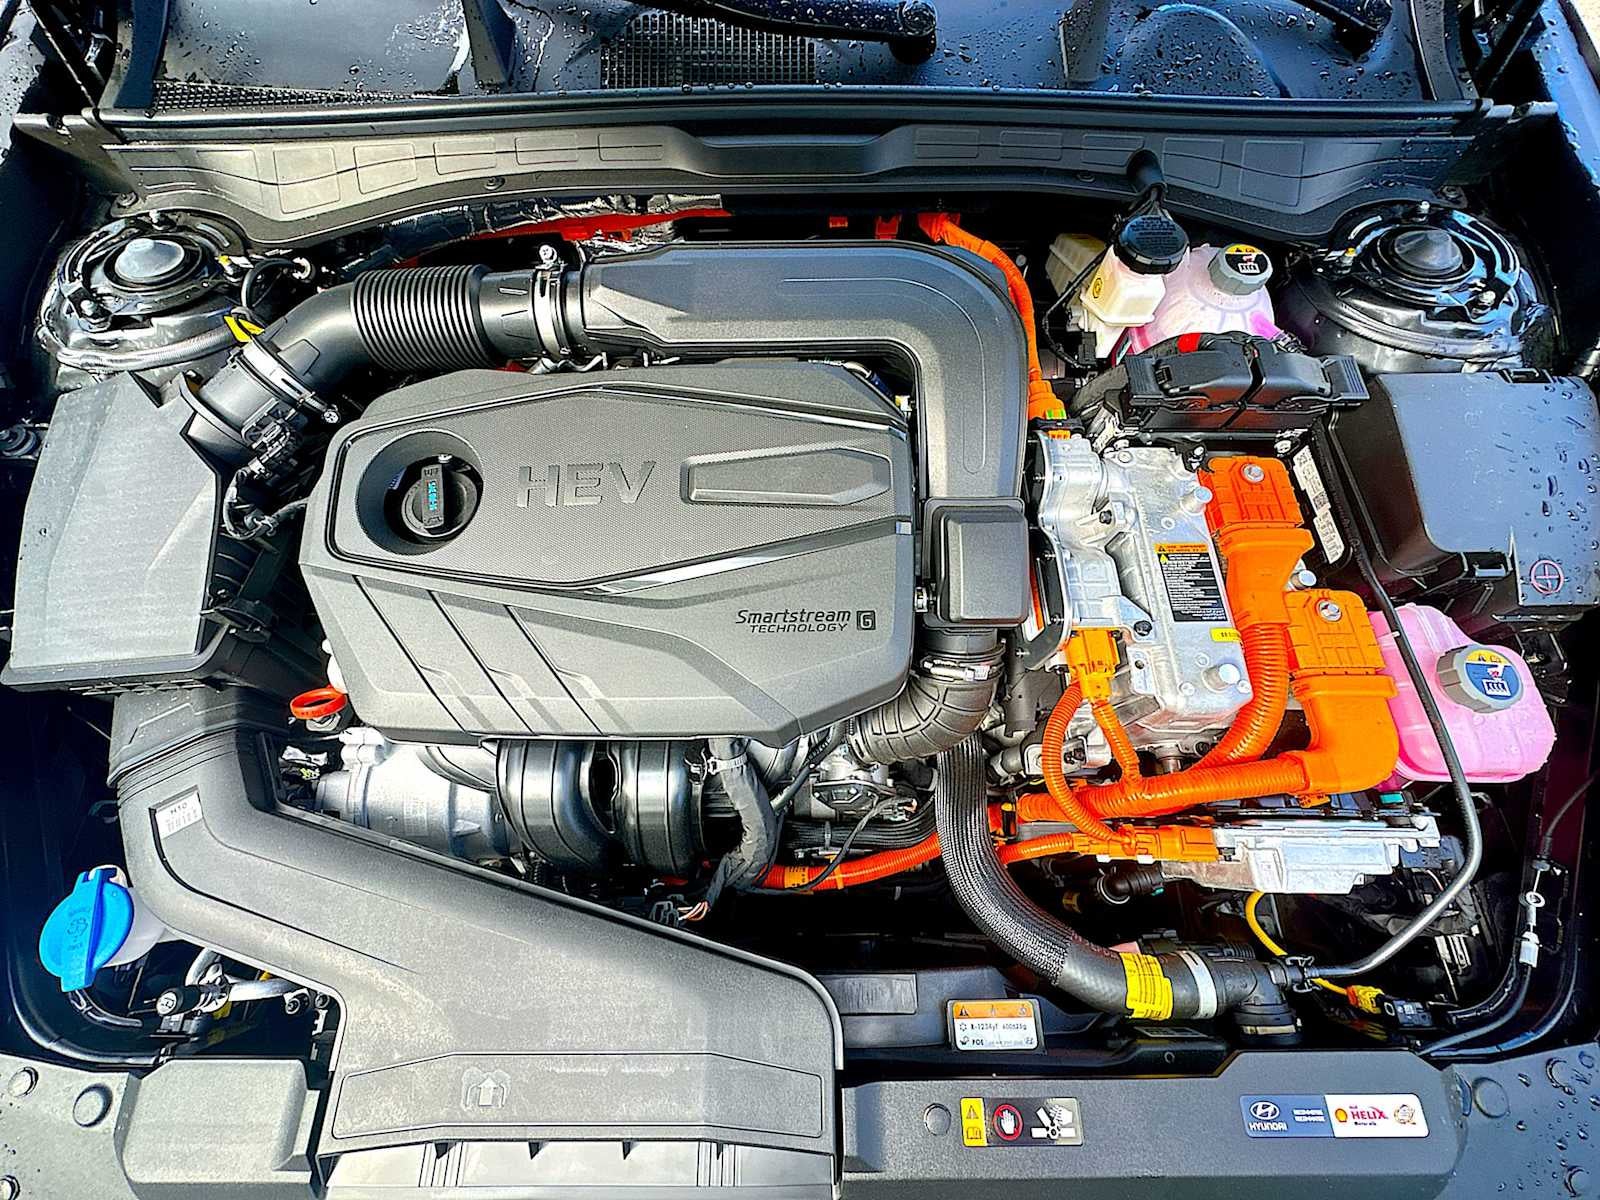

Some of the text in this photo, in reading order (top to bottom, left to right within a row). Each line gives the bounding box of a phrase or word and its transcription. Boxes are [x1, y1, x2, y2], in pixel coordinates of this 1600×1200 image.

[516, 461, 656, 508] HEV
[736, 608, 876, 630] Smartstream G
[750, 623, 848, 633] TECHNOLOGY
[1351, 1110, 1389, 1120] HELIX
[1249, 1122, 1287, 1131] HYUNDAI
